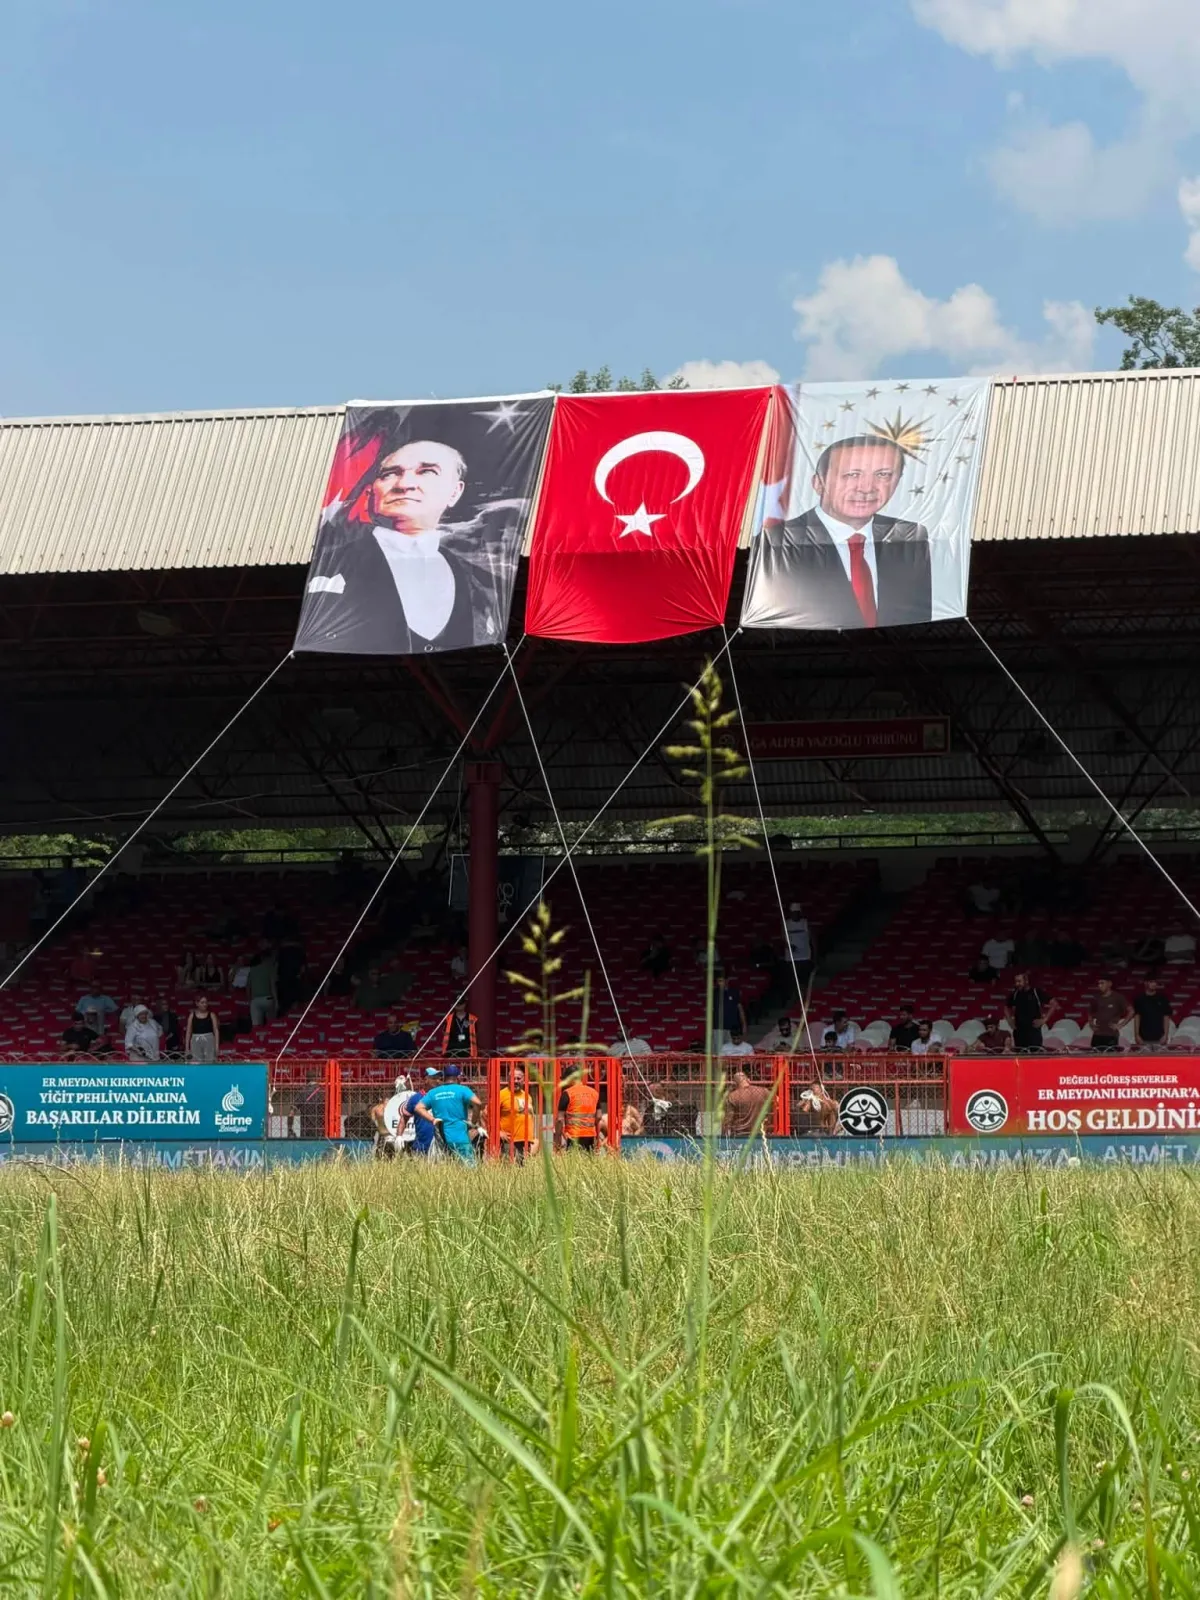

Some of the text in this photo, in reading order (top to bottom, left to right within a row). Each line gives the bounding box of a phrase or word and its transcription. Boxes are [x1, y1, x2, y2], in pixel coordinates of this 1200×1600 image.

[41, 1077, 185, 1087] ER MEYDANI KIRKPINAR'IN
[1059, 1074, 1178, 1086] DEĞERLİ GÜREŞ SEVERLER
[39, 1090, 188, 1104] YİĞİT PEHLİVANLARINA
[1038, 1087, 1200, 1100] ER MEYDANI KIRKPINAR'A
[26, 1106, 200, 1129] BAŞARILAR DİLERİM
[215, 1113, 253, 1126] Edirne
[1086, 1102, 1200, 1130] GELDİNİ
